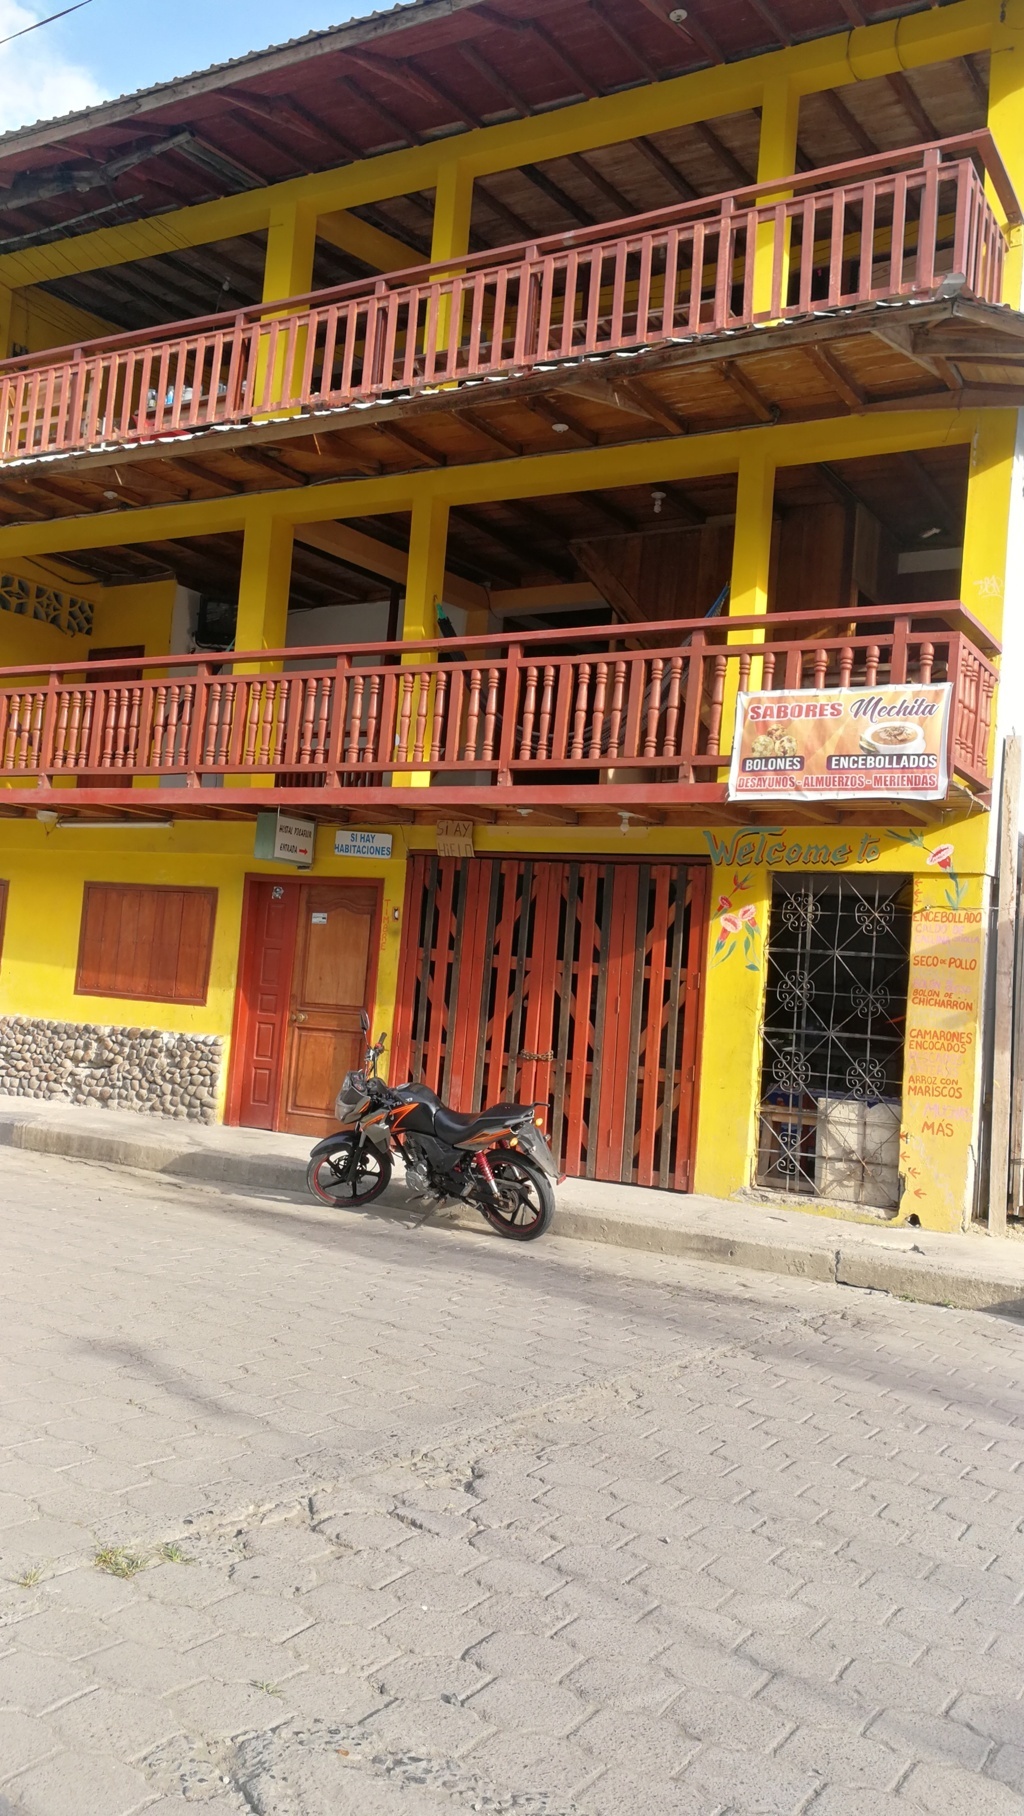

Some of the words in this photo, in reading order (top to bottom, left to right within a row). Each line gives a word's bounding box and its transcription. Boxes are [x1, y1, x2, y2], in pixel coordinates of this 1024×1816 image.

[749, 702, 843, 720] SABORES
[850, 696, 939, 723] Mechita
[745, 757, 801, 771] BOLONES
[831, 755, 938, 769] ENCEBOLLADOS
[738, 776, 795, 788] DESAYUNOS
[803, 774, 865, 787] ALMUERZOS
[873, 774, 936, 787] MERIENDAS
[454, 822, 471, 838] AY
[350, 833, 358, 843] SI
[360, 834, 375, 843] HAY
[335, 843, 391, 856] HABITACIONES
[703, 827, 852, 867] Welcome
[856, 832, 880, 864] to
[381, 899, 391, 950] TIMBRE
[912, 911, 982, 924] ENCEBOLLADO
[913, 955, 939, 968] SECO
[948, 957, 977, 971] POLLO
[909, 1029, 973, 1045] CAMARONES
[908, 1040, 967, 1053] ENCOCADOS
[908, 1075, 937, 1085] ARROZ
[940, 1078, 959, 1086] CON
[907, 1085, 963, 1099] MARISCOS
